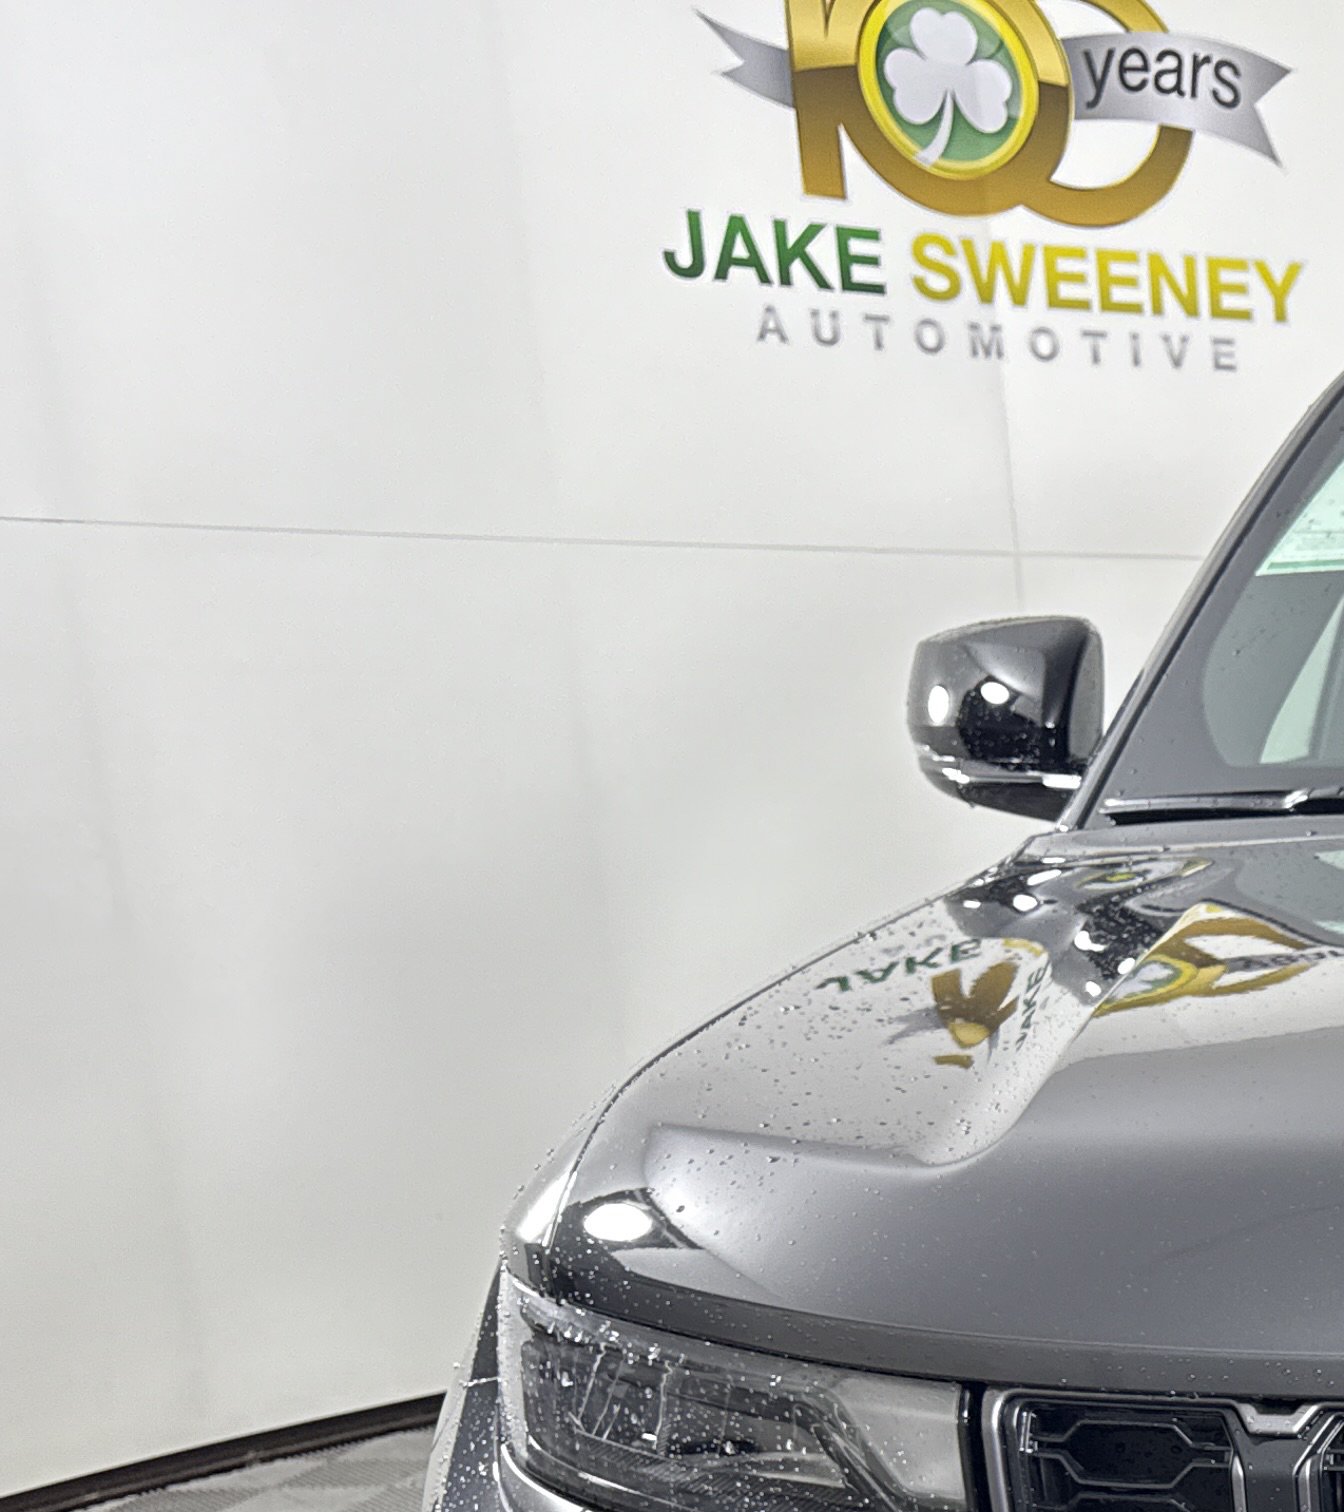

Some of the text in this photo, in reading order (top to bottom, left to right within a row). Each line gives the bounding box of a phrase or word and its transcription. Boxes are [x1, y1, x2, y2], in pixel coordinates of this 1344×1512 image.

[1081, 46, 1243, 109] years
[663, 209, 1304, 322] JAKE SWEENEY
[756, 304, 1237, 371] AUTOMOTIVE
